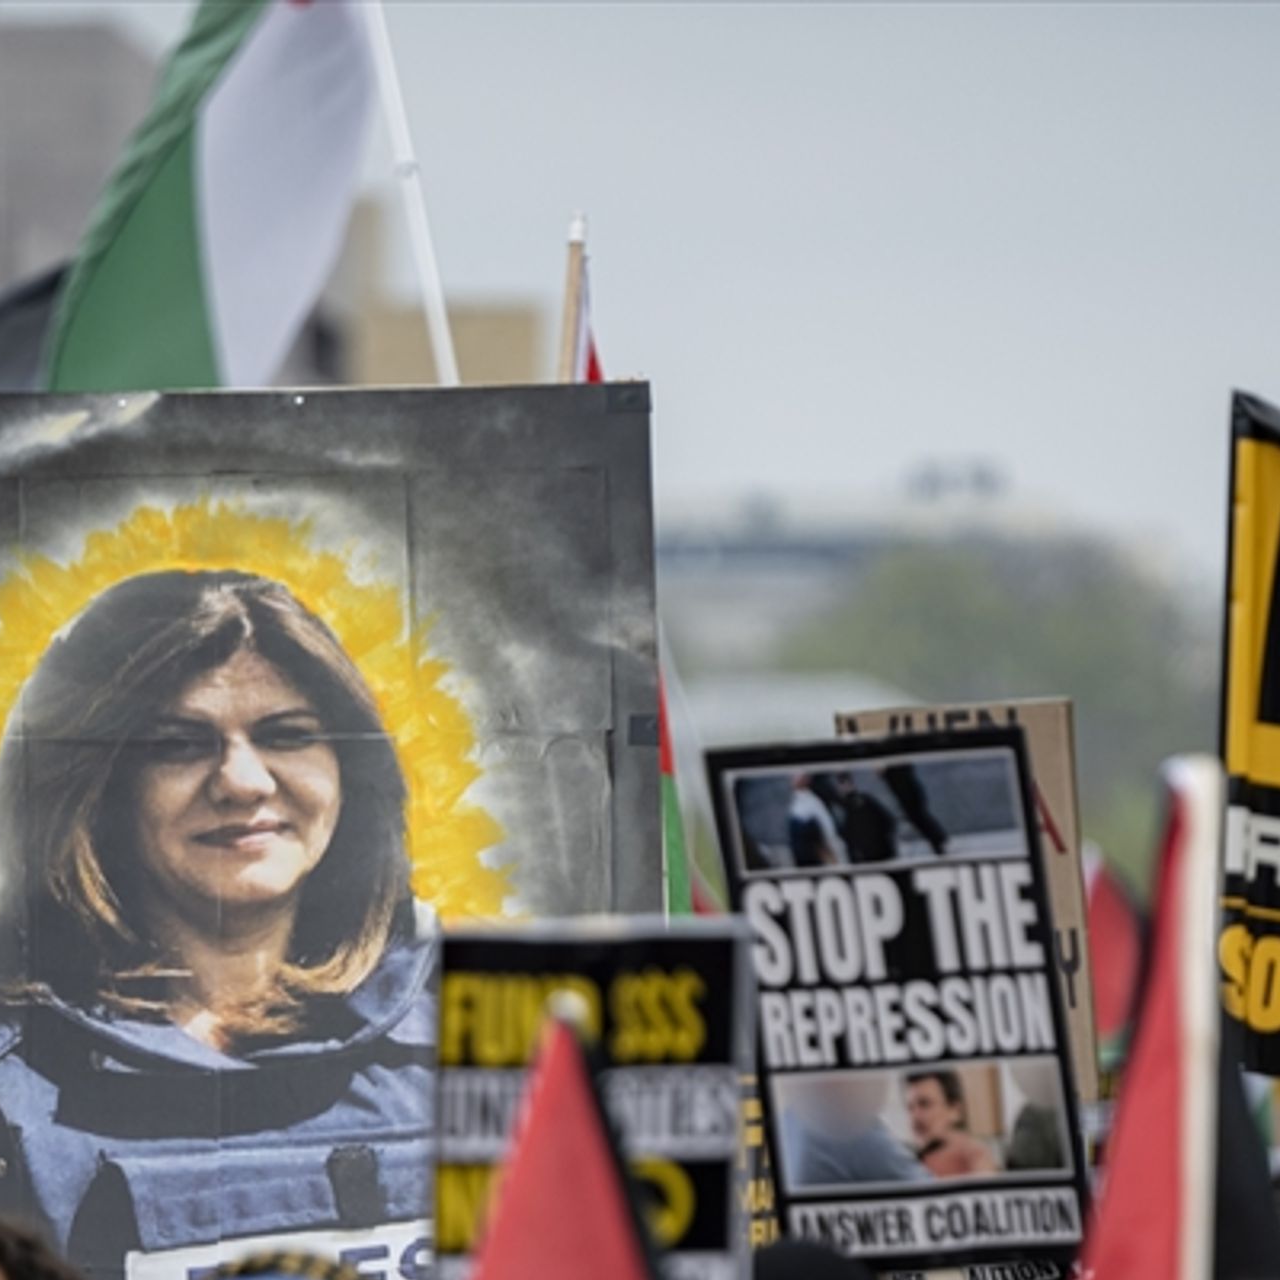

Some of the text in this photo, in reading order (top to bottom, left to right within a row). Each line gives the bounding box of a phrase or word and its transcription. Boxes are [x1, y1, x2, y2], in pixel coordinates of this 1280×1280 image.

[743, 873, 904, 987] STOP
[913, 860, 1046, 973] THE
[758, 973, 1056, 1068] REPRESSION
[796, 1197, 1075, 1252] ANSWER COALITION
